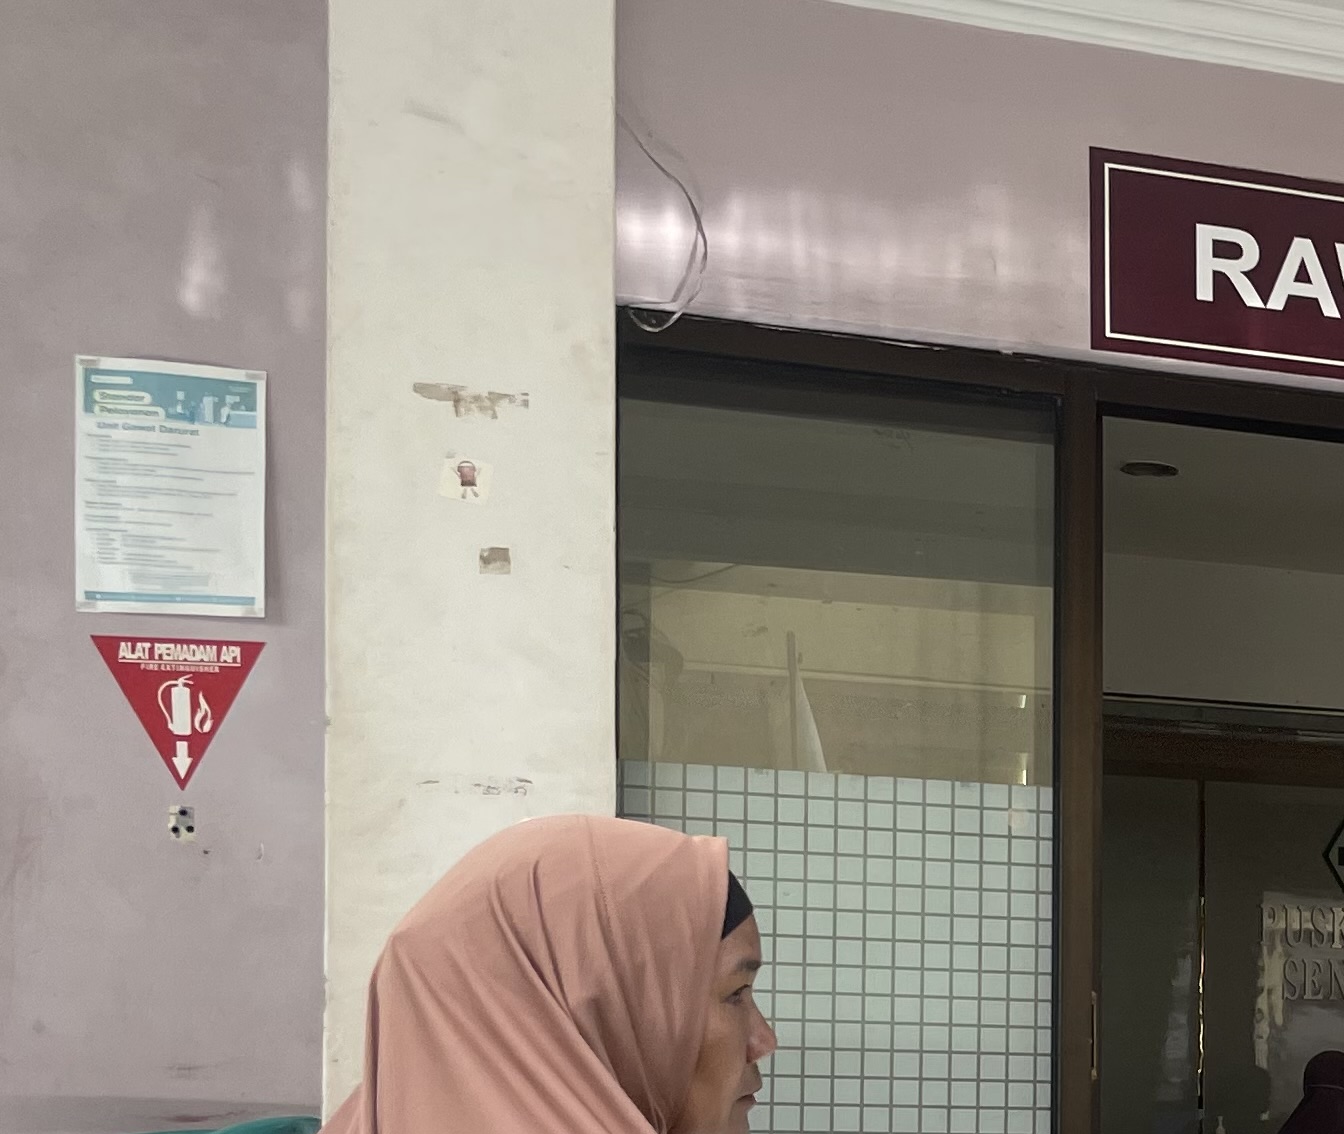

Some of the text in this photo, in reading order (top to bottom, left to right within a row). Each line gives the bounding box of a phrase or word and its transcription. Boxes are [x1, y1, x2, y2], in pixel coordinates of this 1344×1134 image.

[118, 642, 241, 663] ALAT PEMADAM API
